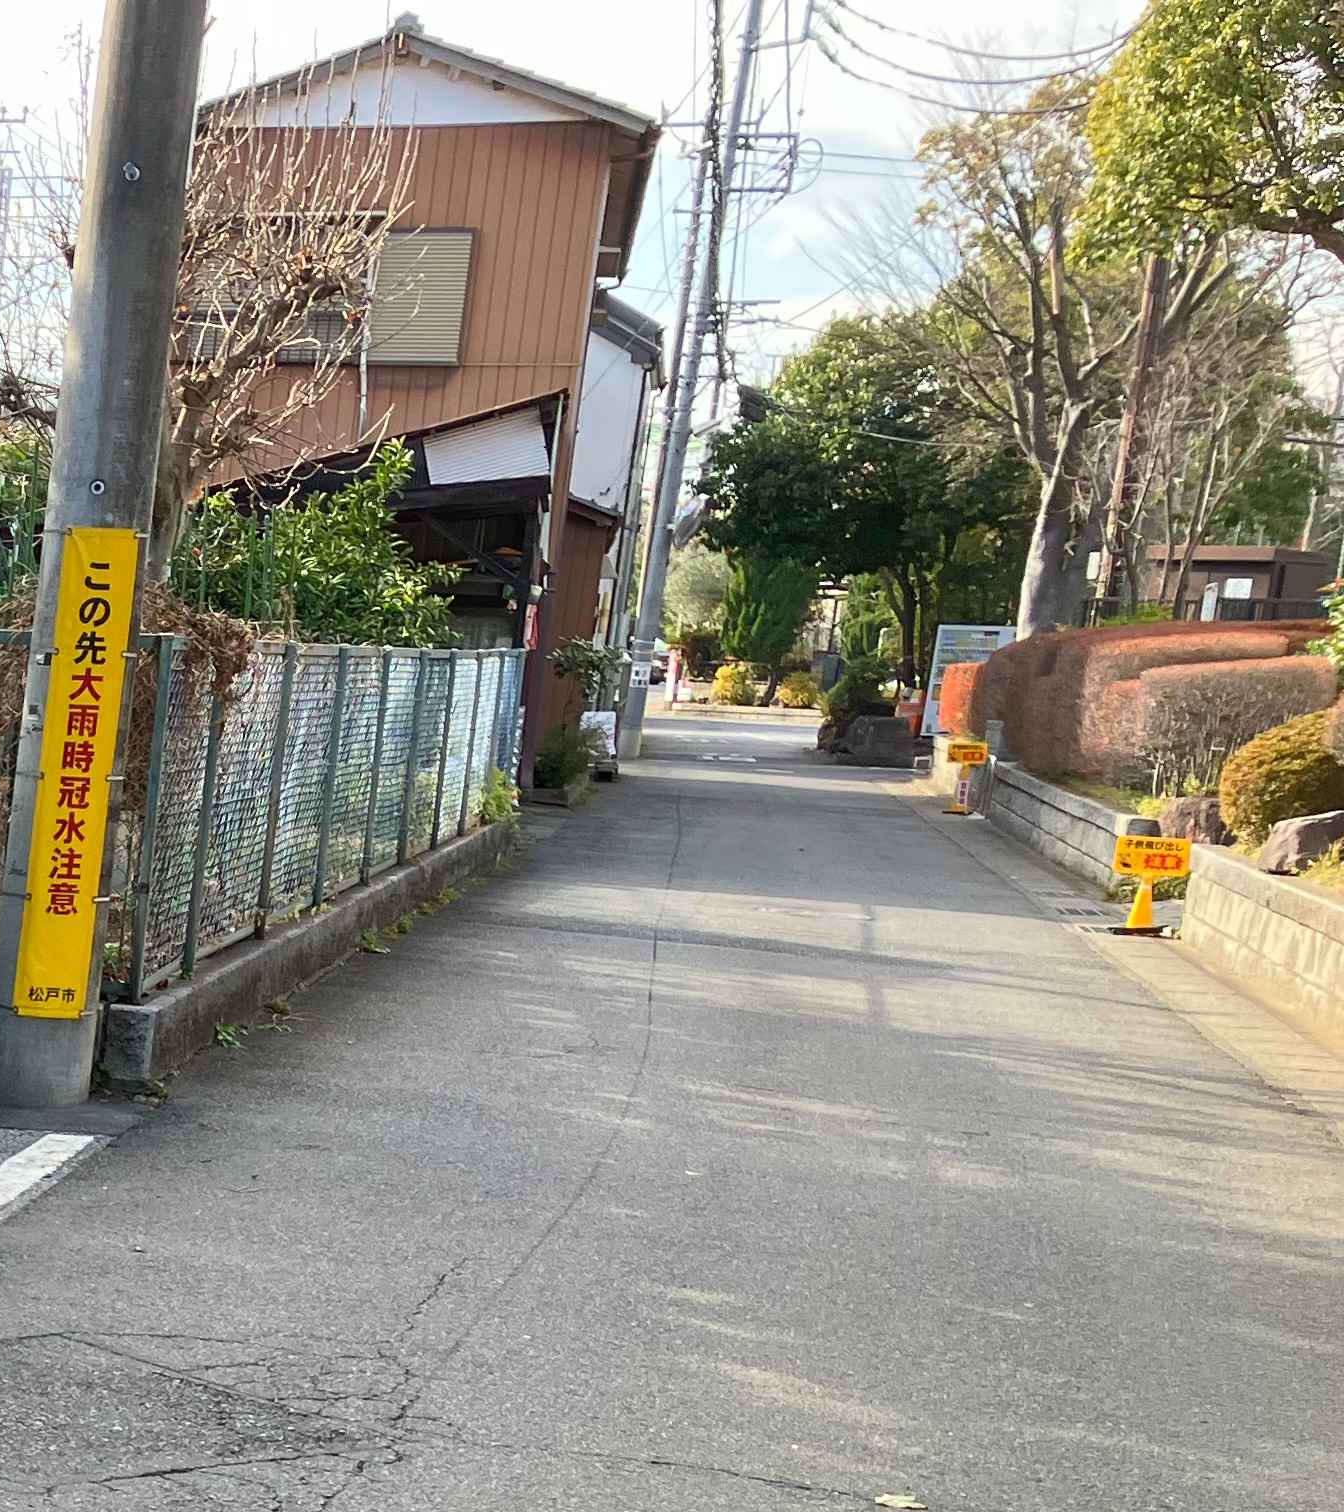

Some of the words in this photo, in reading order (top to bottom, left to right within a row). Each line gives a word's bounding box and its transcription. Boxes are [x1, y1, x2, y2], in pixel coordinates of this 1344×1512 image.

[45, 562, 111, 915] この先大雨時冠水注意
[28, 986, 76, 1003] 松戸市
